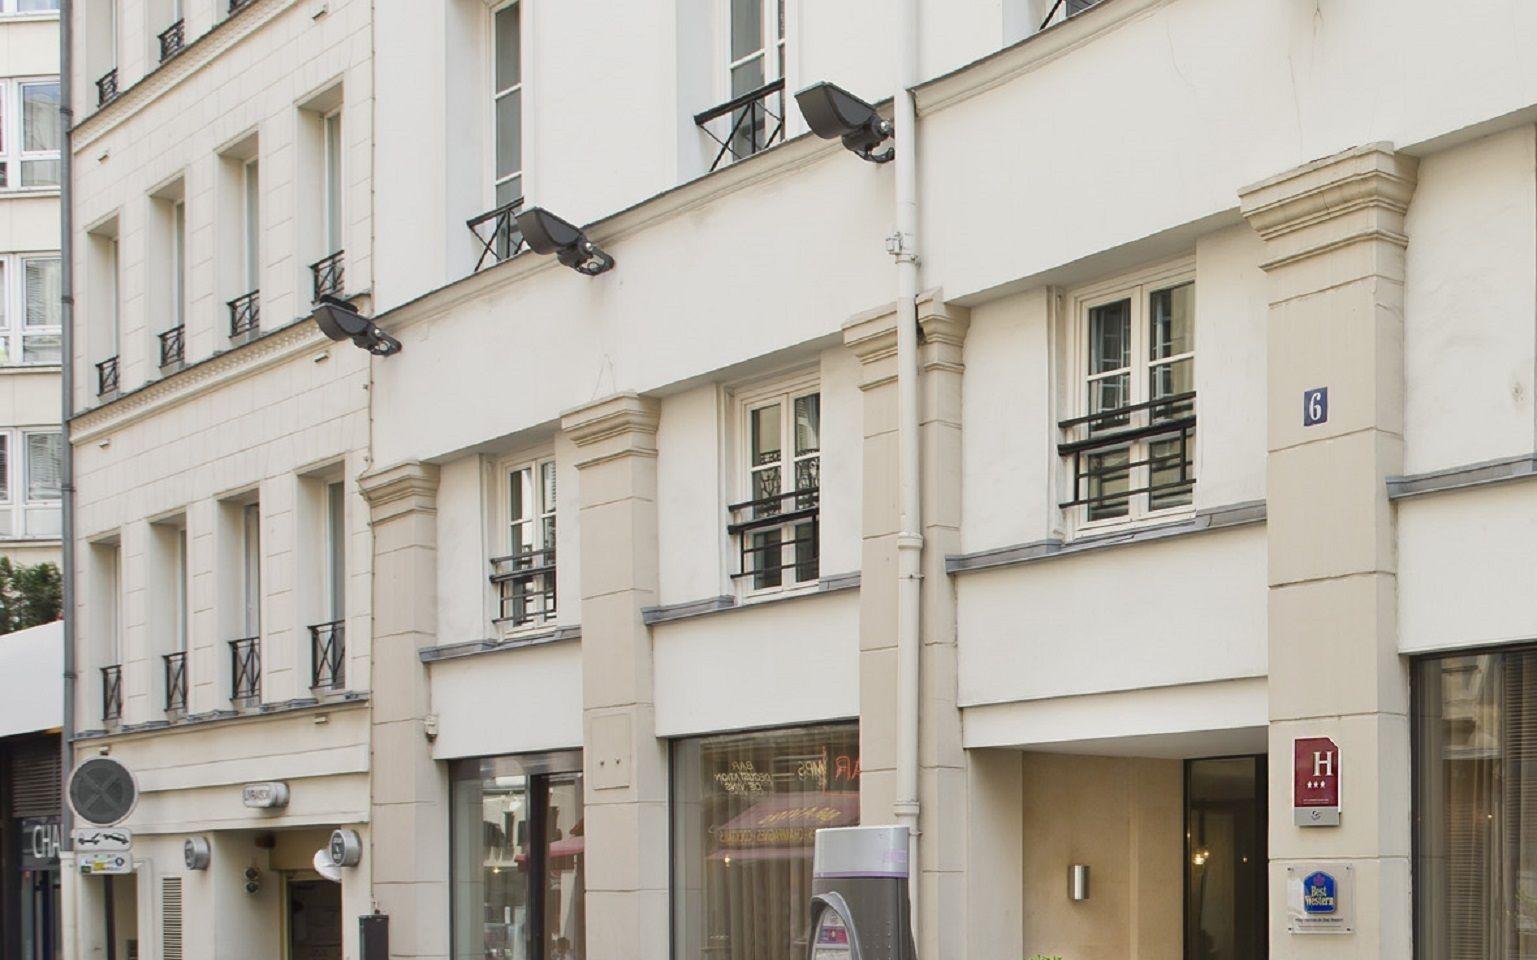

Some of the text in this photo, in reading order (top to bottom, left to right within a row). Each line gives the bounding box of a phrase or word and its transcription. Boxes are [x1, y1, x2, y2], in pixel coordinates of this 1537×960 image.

[1309, 392, 1322, 421] 6
[1313, 751, 1334, 777] H
[33, 825, 64, 858] CHA
[1304, 895, 1334, 906] Western
[1311, 885, 1327, 897] Best
